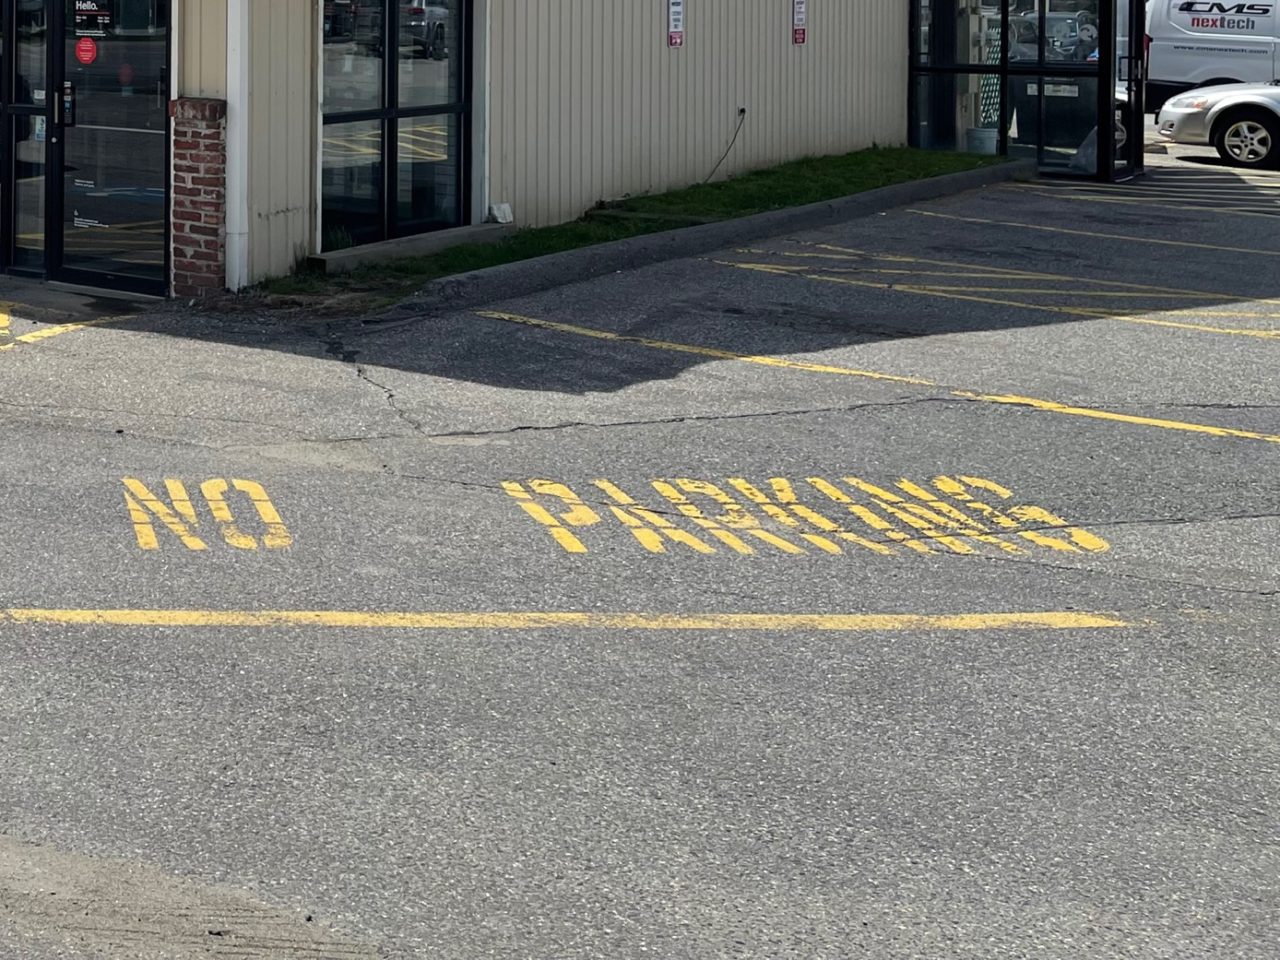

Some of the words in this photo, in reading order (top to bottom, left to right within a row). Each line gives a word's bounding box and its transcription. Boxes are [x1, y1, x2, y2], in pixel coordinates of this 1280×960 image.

[75, 0, 98, 10] Hello.
[1178, 2, 1273, 15] CMS
[1191, 16, 1255, 30] nextech
[122, 478, 293, 551] NO
[500, 477, 1111, 555] PARKING
